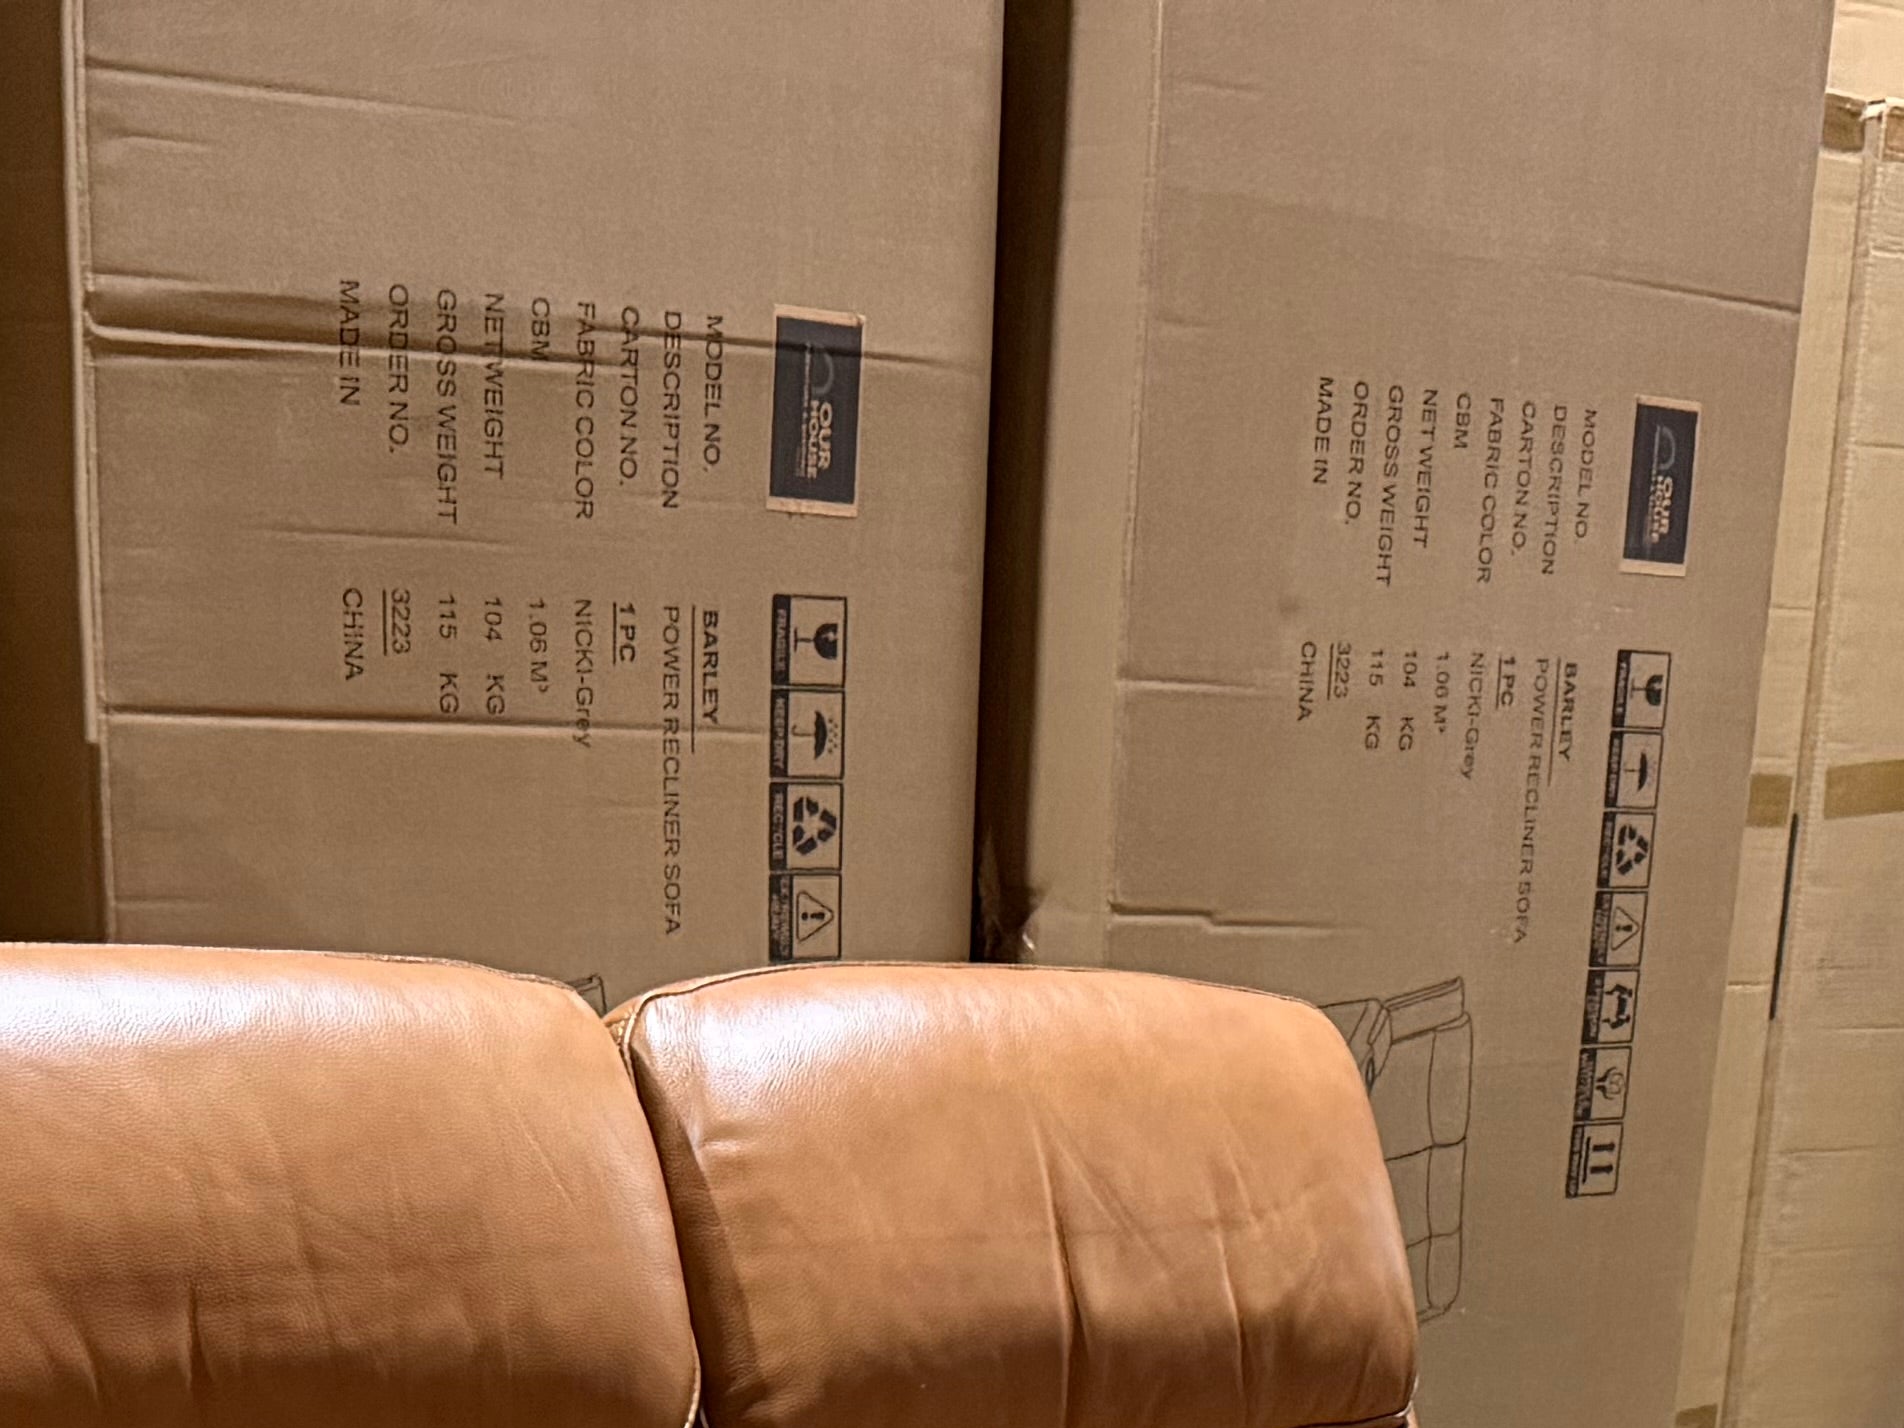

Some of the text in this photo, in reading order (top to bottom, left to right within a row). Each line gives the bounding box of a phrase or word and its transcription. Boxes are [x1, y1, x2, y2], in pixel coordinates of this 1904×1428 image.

[340, 280, 360, 406] MADE IN
[389, 284, 409, 453] ORDER NO.
[532, 297, 551, 361] CBM
[437, 289, 457, 525] GROSS WEIGHT
[575, 302, 595, 519] FABRIC COLOR
[619, 306, 640, 486] CARTON NO.
[661, 311, 682, 509] DESCRIPTION
[702, 316, 723, 472] MODEL NO.
[818, 402, 833, 470] OUR
[1312, 376, 1334, 484] MADE IN
[1453, 391, 1471, 449] CBM
[1577, 409, 1597, 496] MODEL
[1344, 381, 1369, 525] ORDER NO.
[1376, 385, 1404, 588] GROSS WEIGHT
[1413, 389, 1439, 549] NET WEIGHT
[1476, 397, 1504, 584] FABRIC COLOR
[1515, 400, 1536, 507] CARTON
[1541, 405, 1567, 576] DESCRIPTION
[343, 588, 364, 680] CHINA
[391, 588, 411, 654] 3223
[439, 595, 459, 715] 115 KG
[484, 596, 506, 715] 104 KG
[572, 600, 594, 749] NICKI-Grey
[619, 603, 636, 663] 1 PC
[703, 610, 719, 725] BARLEY
[1333, 642, 1352, 699] 3223
[1297, 641, 1317, 722] CHINA
[1365, 649, 1384, 750] 115 KG
[1399, 651, 1418, 751] 104 KG
[1501, 674, 1516, 706] PC
[1558, 662, 1577, 762] BARLEY
[662, 606, 681, 935] POWER RECLINER SOFA
[772, 793, 784, 860] RECYCLE
[1514, 658, 1549, 944] POWER RECLINER SOFA
